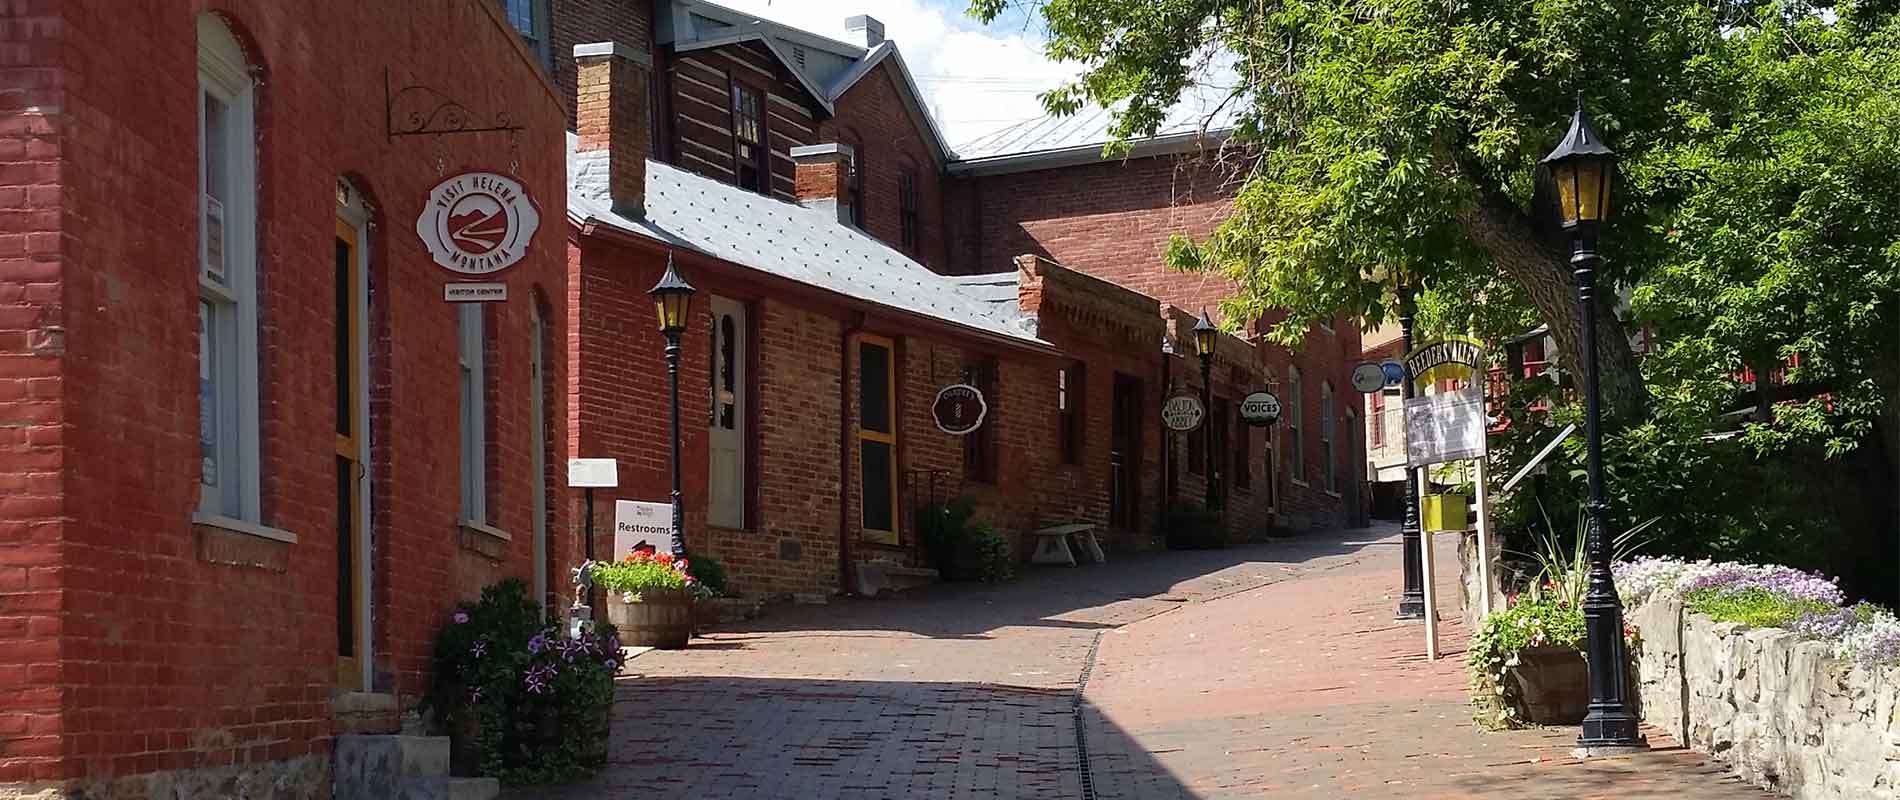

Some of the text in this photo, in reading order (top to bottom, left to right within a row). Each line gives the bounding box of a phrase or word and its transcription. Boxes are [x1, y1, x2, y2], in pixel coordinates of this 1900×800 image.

[436, 176, 517, 208] VISIT HELENA
[449, 248, 512, 271] MONTANA
[448, 288, 504, 297] VISITOR CENTER
[1408, 343, 1449, 379] REEDERS
[1451, 341, 1480, 368] ALLEY
[1244, 403, 1278, 413] VOICES
[618, 521, 671, 535] Restrooms
